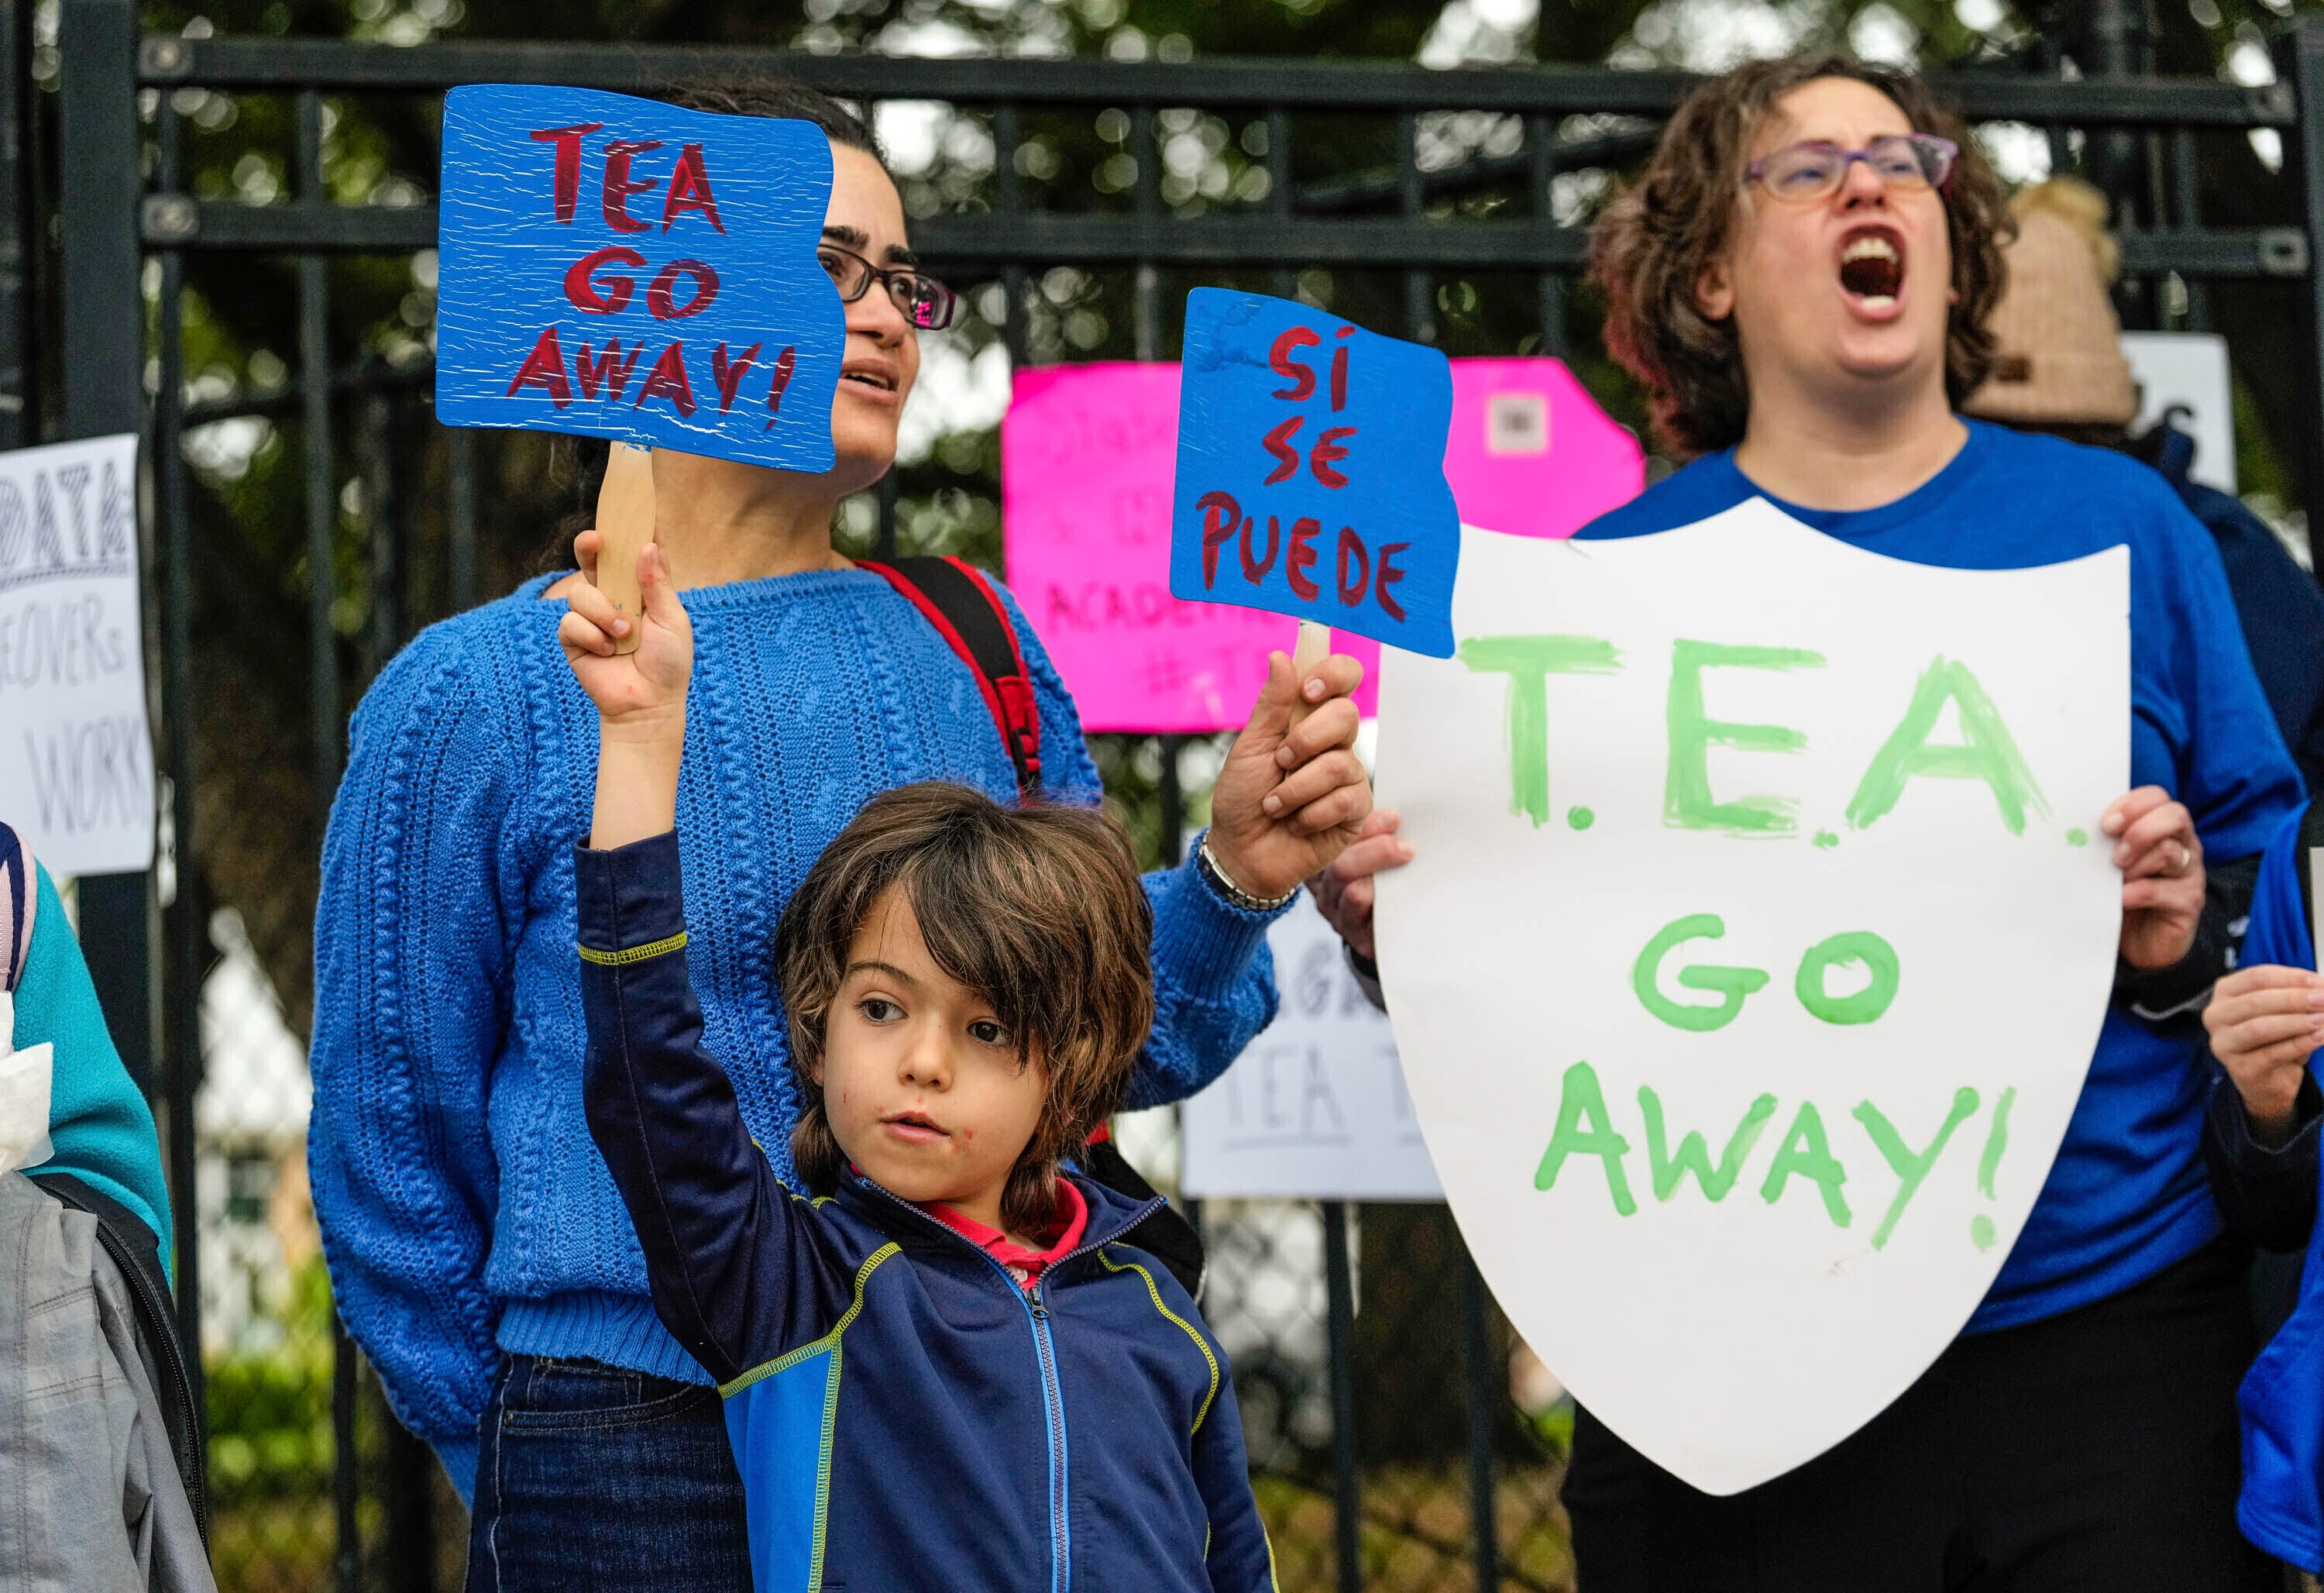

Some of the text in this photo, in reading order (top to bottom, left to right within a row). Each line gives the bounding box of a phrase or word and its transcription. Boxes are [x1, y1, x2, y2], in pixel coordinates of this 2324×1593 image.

[529, 122, 727, 236] TEA
[563, 246, 720, 322] GO
[506, 326, 796, 432] AWAY!
[1262, 415, 1358, 489] SE
[1195, 490, 1413, 623] PUEDE
[1457, 634, 2089, 850] T.E.A.
[1629, 913, 1900, 1032] GO
[1533, 1060, 2016, 1253] AWAY!
